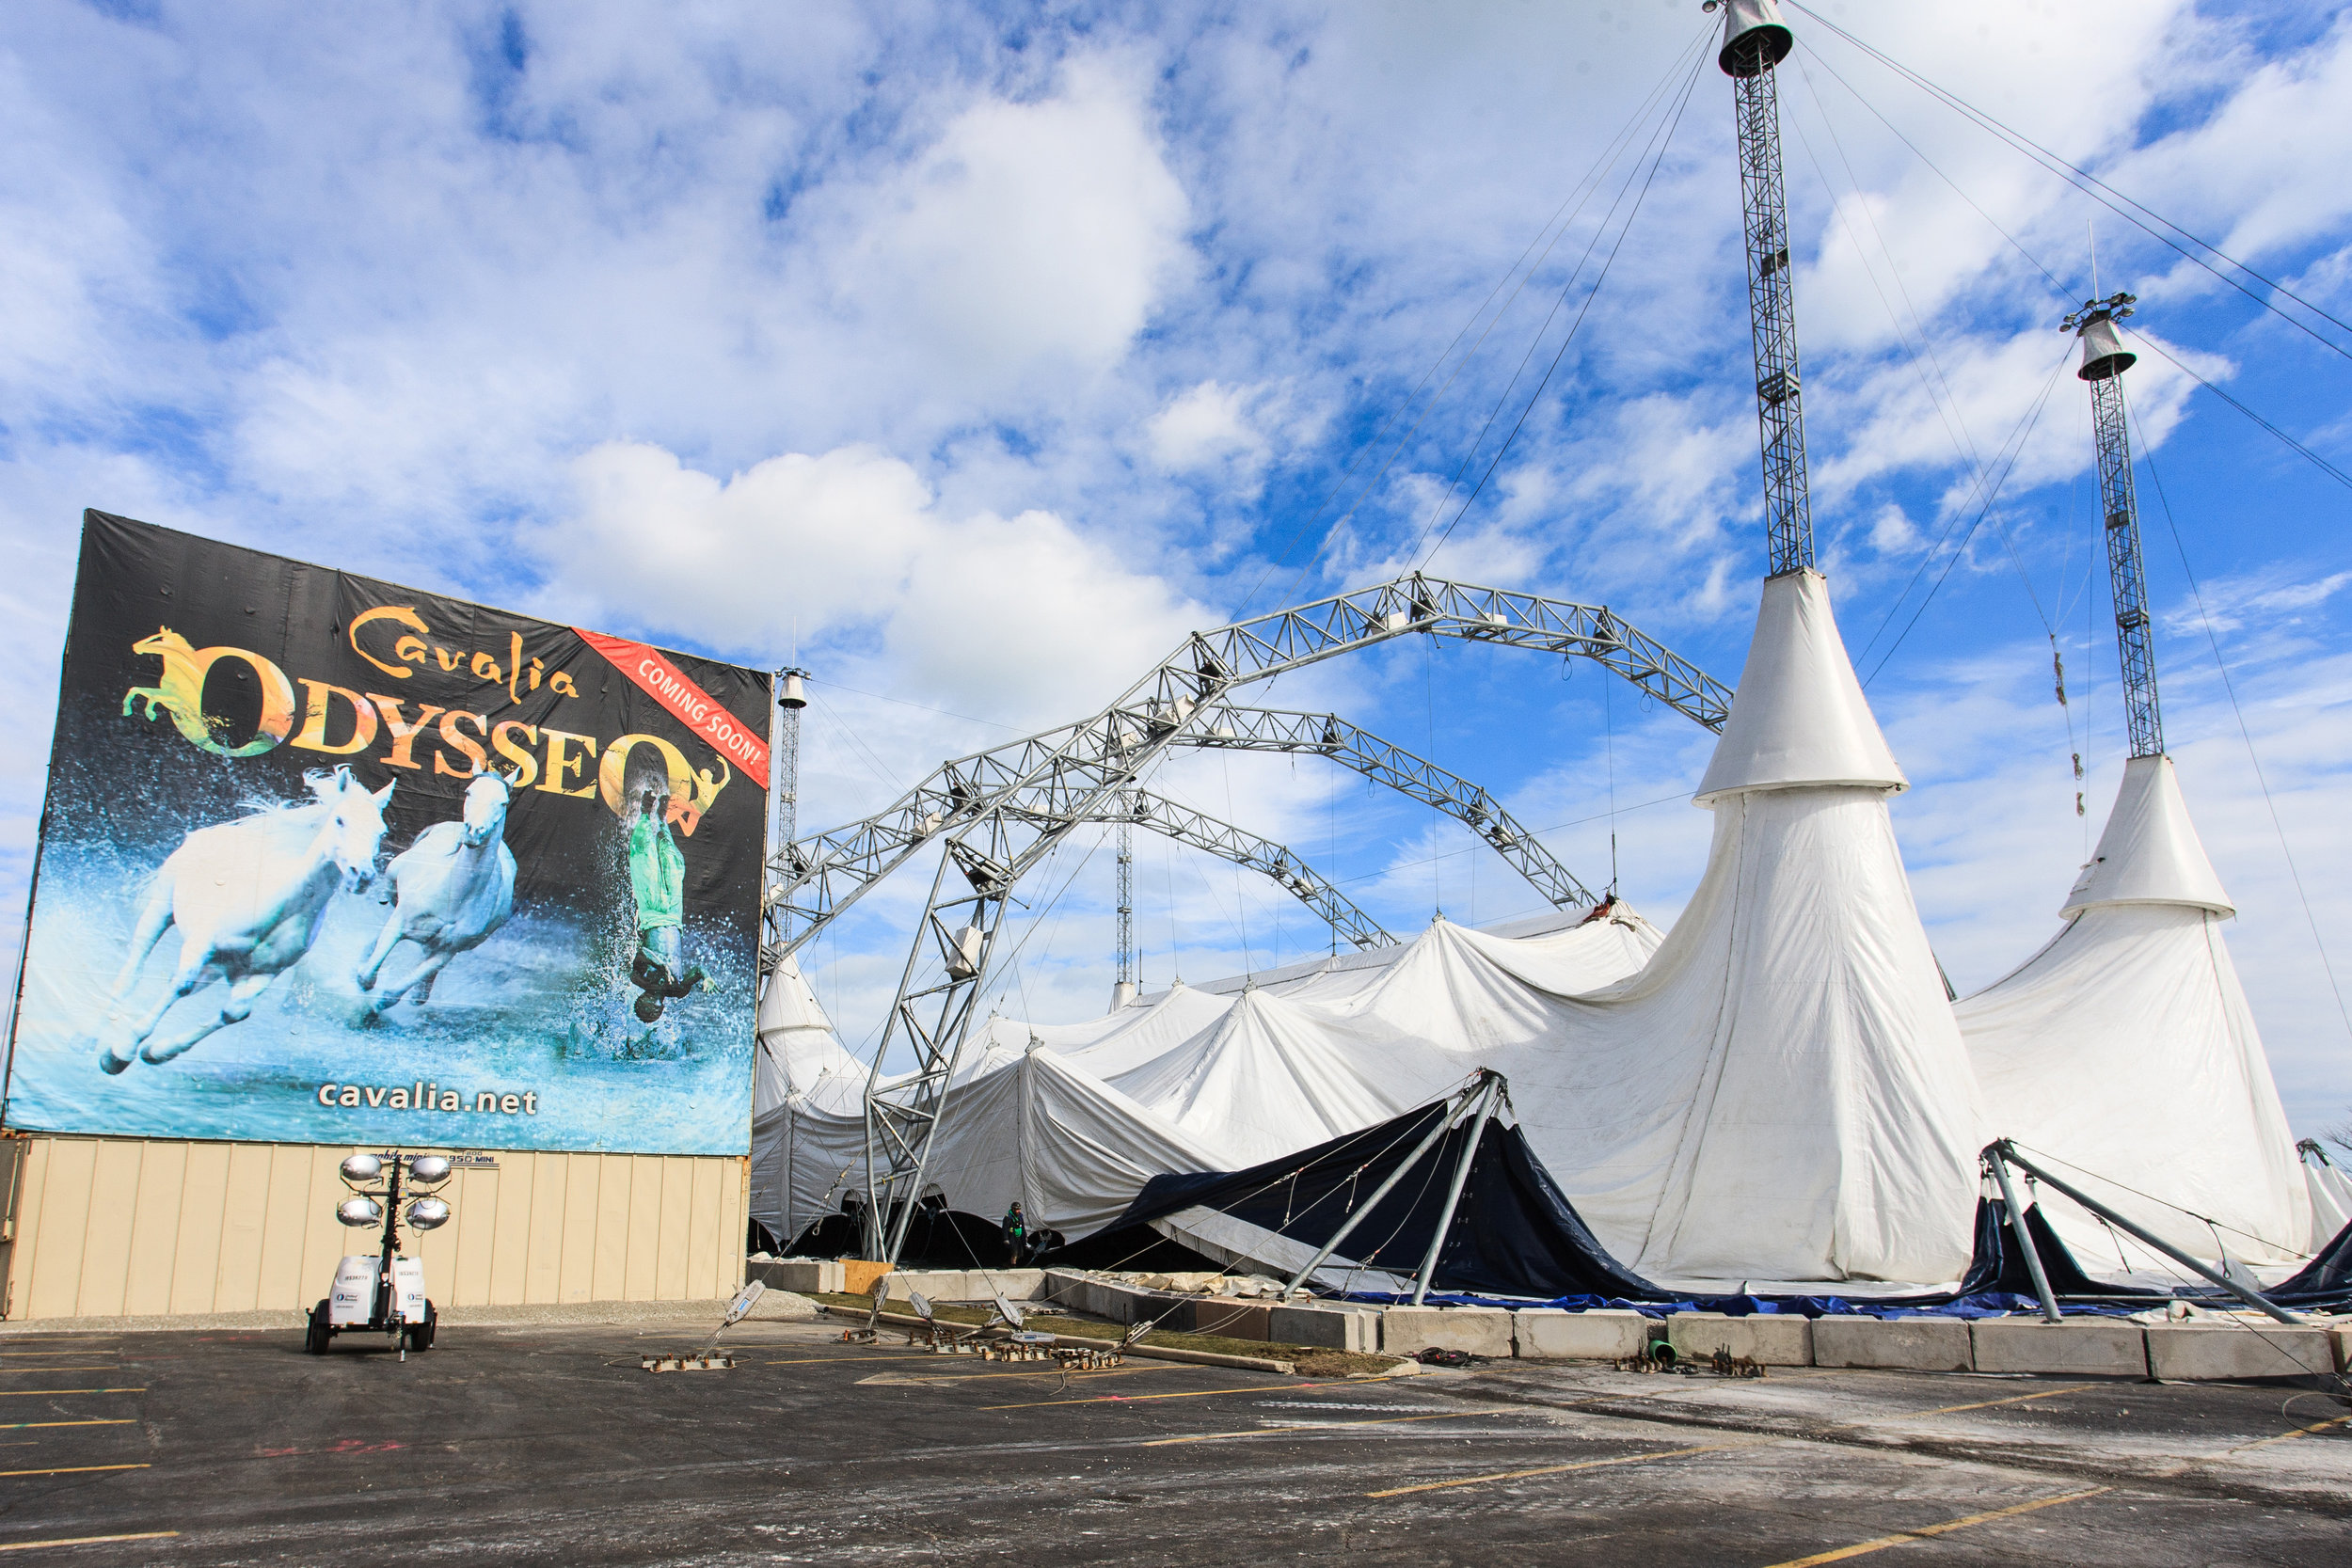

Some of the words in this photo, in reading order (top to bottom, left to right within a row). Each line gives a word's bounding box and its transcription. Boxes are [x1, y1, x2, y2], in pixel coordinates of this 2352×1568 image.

[349, 606, 580, 705] Cavalia
[162, 645, 701, 820] ODYSSEO
[638, 658, 708, 722] COMING
[706, 715, 761, 766] SOON!
[318, 1081, 537, 1116] cavalia.net
